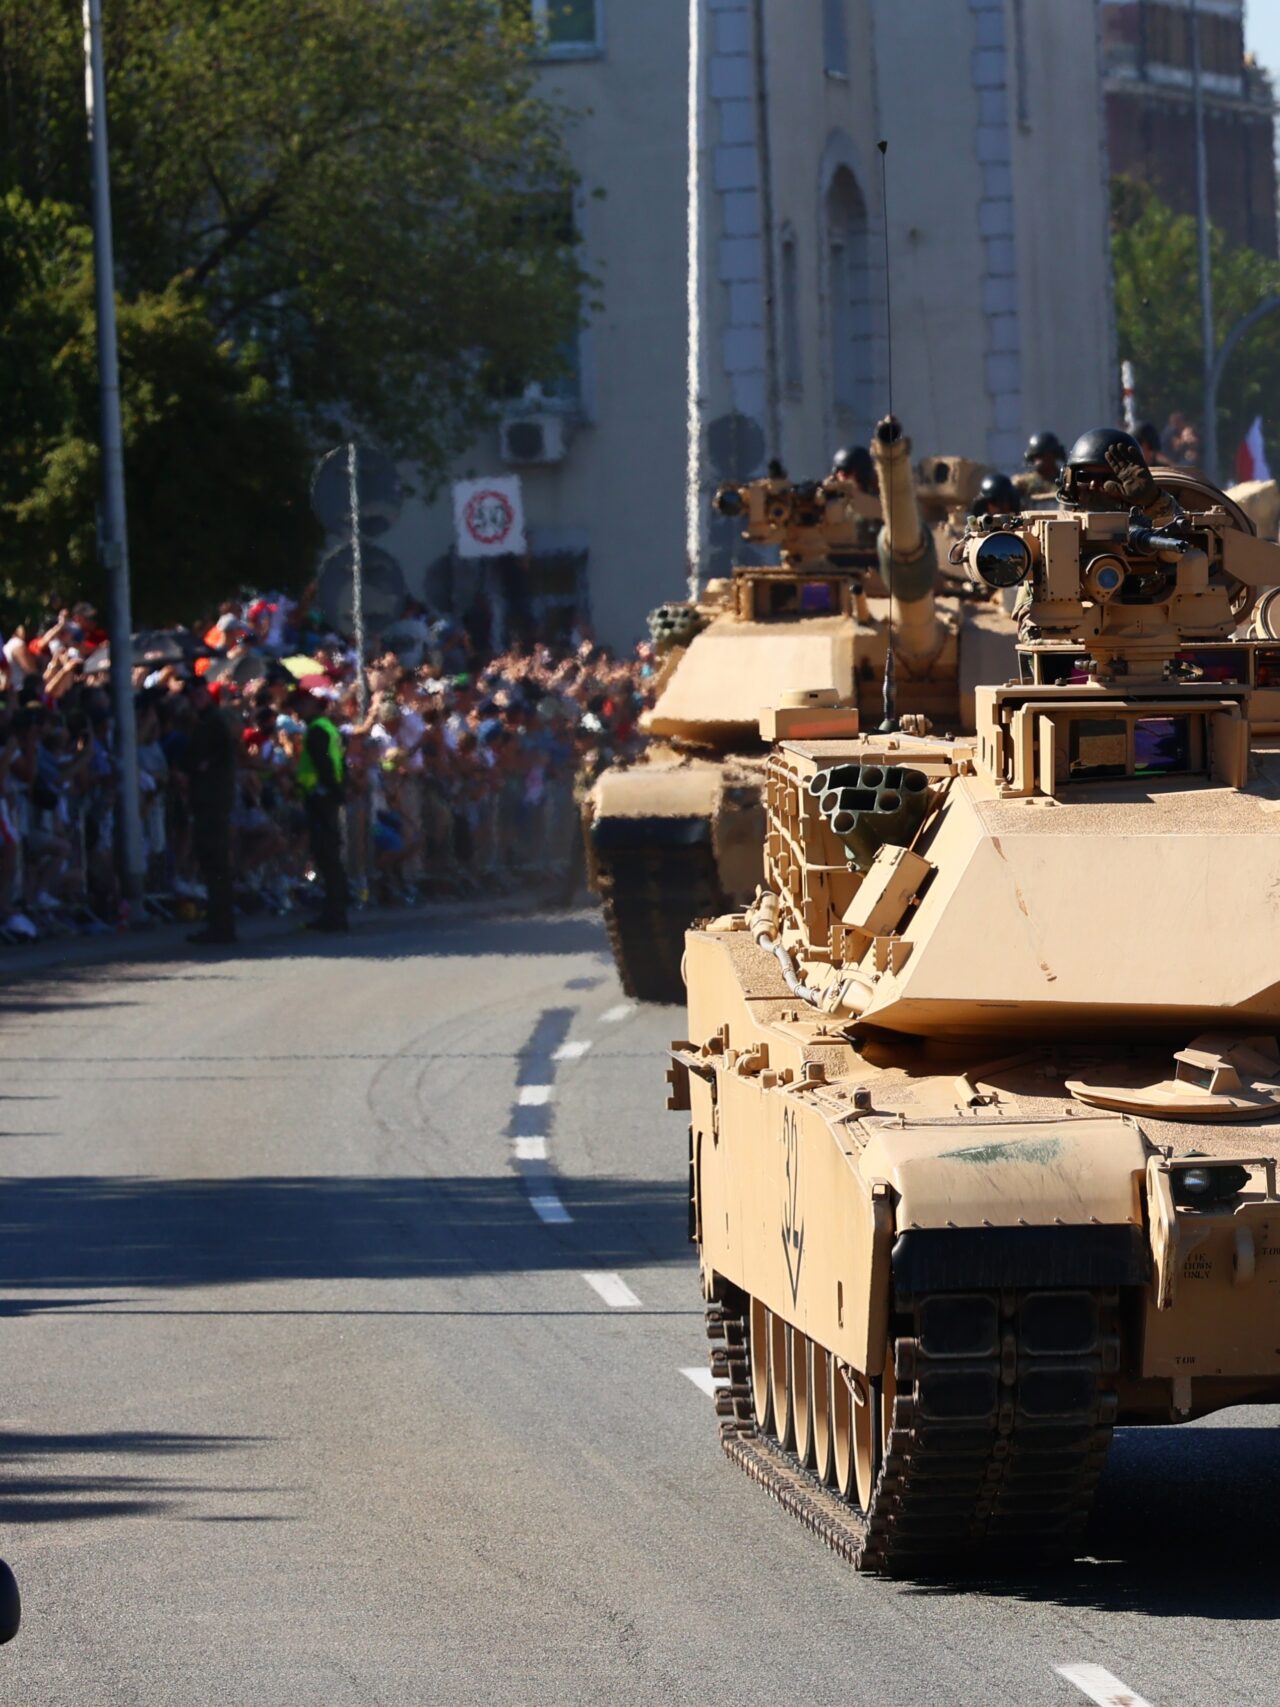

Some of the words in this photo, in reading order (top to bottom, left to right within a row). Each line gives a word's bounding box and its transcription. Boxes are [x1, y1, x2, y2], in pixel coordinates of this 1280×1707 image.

[783, 1105, 799, 1249] 32
[1184, 1262, 1212, 1270] DOWN
[1183, 1270, 1210, 1279] ONLY
